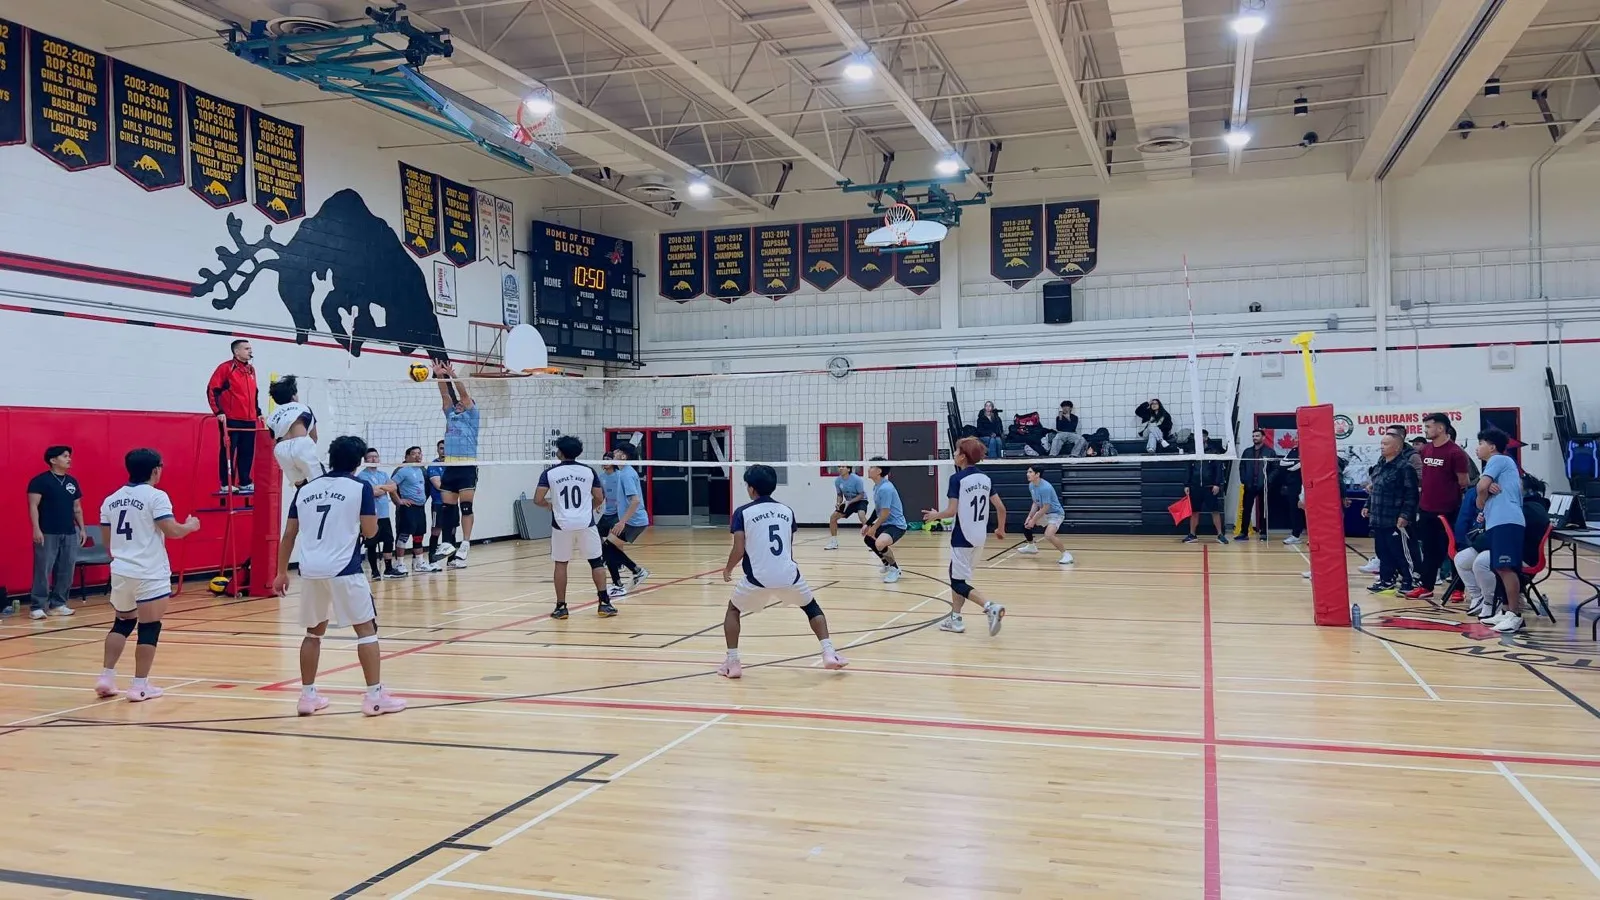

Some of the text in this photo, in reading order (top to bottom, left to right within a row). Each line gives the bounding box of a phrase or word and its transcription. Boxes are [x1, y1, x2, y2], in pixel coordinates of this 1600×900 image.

[43, 39, 96, 68] 2002-2003
[46, 54, 94, 81] ROPSSAA
[41, 68, 98, 94] GIRLS CURLING
[124, 74, 170, 100] 2003-2004
[42, 82, 96, 106] VARSITY BOYS
[128, 90, 168, 114] ROPSSAA
[52, 97, 88, 116] BASEBALL
[122, 102, 172, 129] CHAMPIONS
[196, 95, 236, 119] 2004-2005
[42, 108, 96, 132] VARSITY BOYS
[198, 108, 234, 130] ROPSSAA
[258, 118, 294, 139] 2005-2006
[51, 122, 89, 142] LACROSSE
[122, 119, 172, 142] GIRLS CURLING
[193, 118, 238, 142] CHAMPIONS
[260, 129, 293, 150] ROPSSAA
[120, 130, 176, 156] GIRLS FASTPITCH
[196, 134, 238, 154] GIRLS CURLING
[257, 140, 296, 162] CHAMPIONS
[196, 154, 238, 174] VARSITY BOYS
[216, 150, 244, 166] WRESTLING
[202, 166, 232, 182] LACROSSE
[546, 228, 596, 246] HOME OF THE
[714, 234, 742, 244] 2011-2012
[762, 230, 790, 239] 2013-2014
[763, 238, 788, 248] ROPSSAA
[1000, 230, 1034, 238] CHAMPIONS
[554, 240, 590, 257] BUCKS
[667, 252, 696, 261] CHAMPIONS
[714, 250, 744, 260] CHAMPIONS
[761, 247, 792, 256] CHAMPIONS
[544, 276, 562, 288] HOME
[574, 266, 604, 290] 10:50
[580, 290, 594, 299] PERIOD
[611, 288, 628, 299] GUEST
[1358, 413, 1419, 425] LALIGURANS
[1368, 426, 1376, 436] &
[1424, 457, 1444, 466] CRUZE
[109, 498, 144, 512] TRIPLE ACES
[303, 492, 346, 505] TRIPLE ACES
[560, 485, 582, 510] 10
[752, 512, 790, 524] TRIPLE ACES
[970, 494, 986, 522] 12
[116, 510, 132, 540] 4
[316, 504, 331, 540] 7
[768, 524, 784, 556] 5
